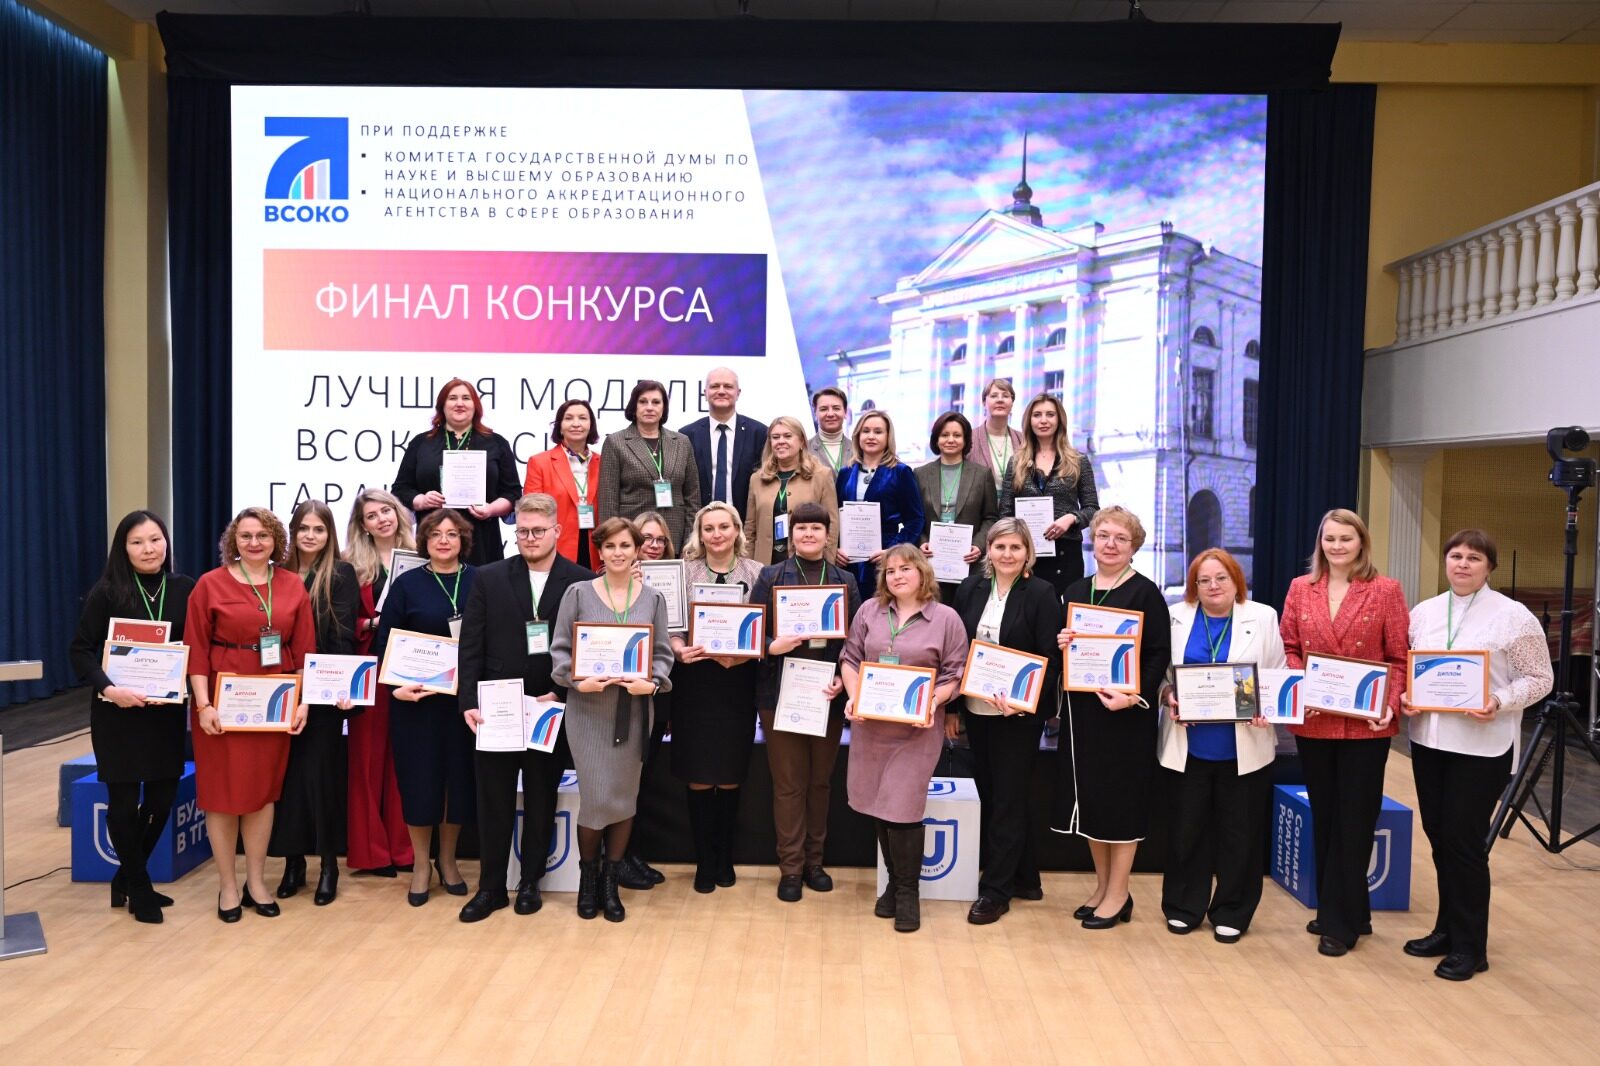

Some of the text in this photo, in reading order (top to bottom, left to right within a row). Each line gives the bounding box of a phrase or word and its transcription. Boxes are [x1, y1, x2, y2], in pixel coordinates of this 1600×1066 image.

[360, 125, 507, 139] ПРИ ПОДДЕРЖКЕ
[384, 151, 748, 167] КОМИТЕТА ГОСУДАРСТВЕННОЙ ДУМЫ ПО
[384, 169, 693, 183] НАУКЕ И ВЫСШЕМУ ОБРАЗОВАНИЮ
[384, 188, 745, 203] НАЦИОНАЛЬНОГО АККРЕДИТАЦИОННОГО
[264, 205, 349, 222] ВСОКО
[384, 206, 694, 220] АГЕНТСТВА В СФЕРЕ ОБРАЗОВАНИЯ
[315, 281, 714, 323] ФИНАЛ КОНКУРСА
[304, 375, 709, 419] ЛУЧШЯ МОДЛ
[297, 428, 411, 463] ВСОК
[177, 799, 207, 828] БУД
[176, 820, 209, 854] В ТГ
